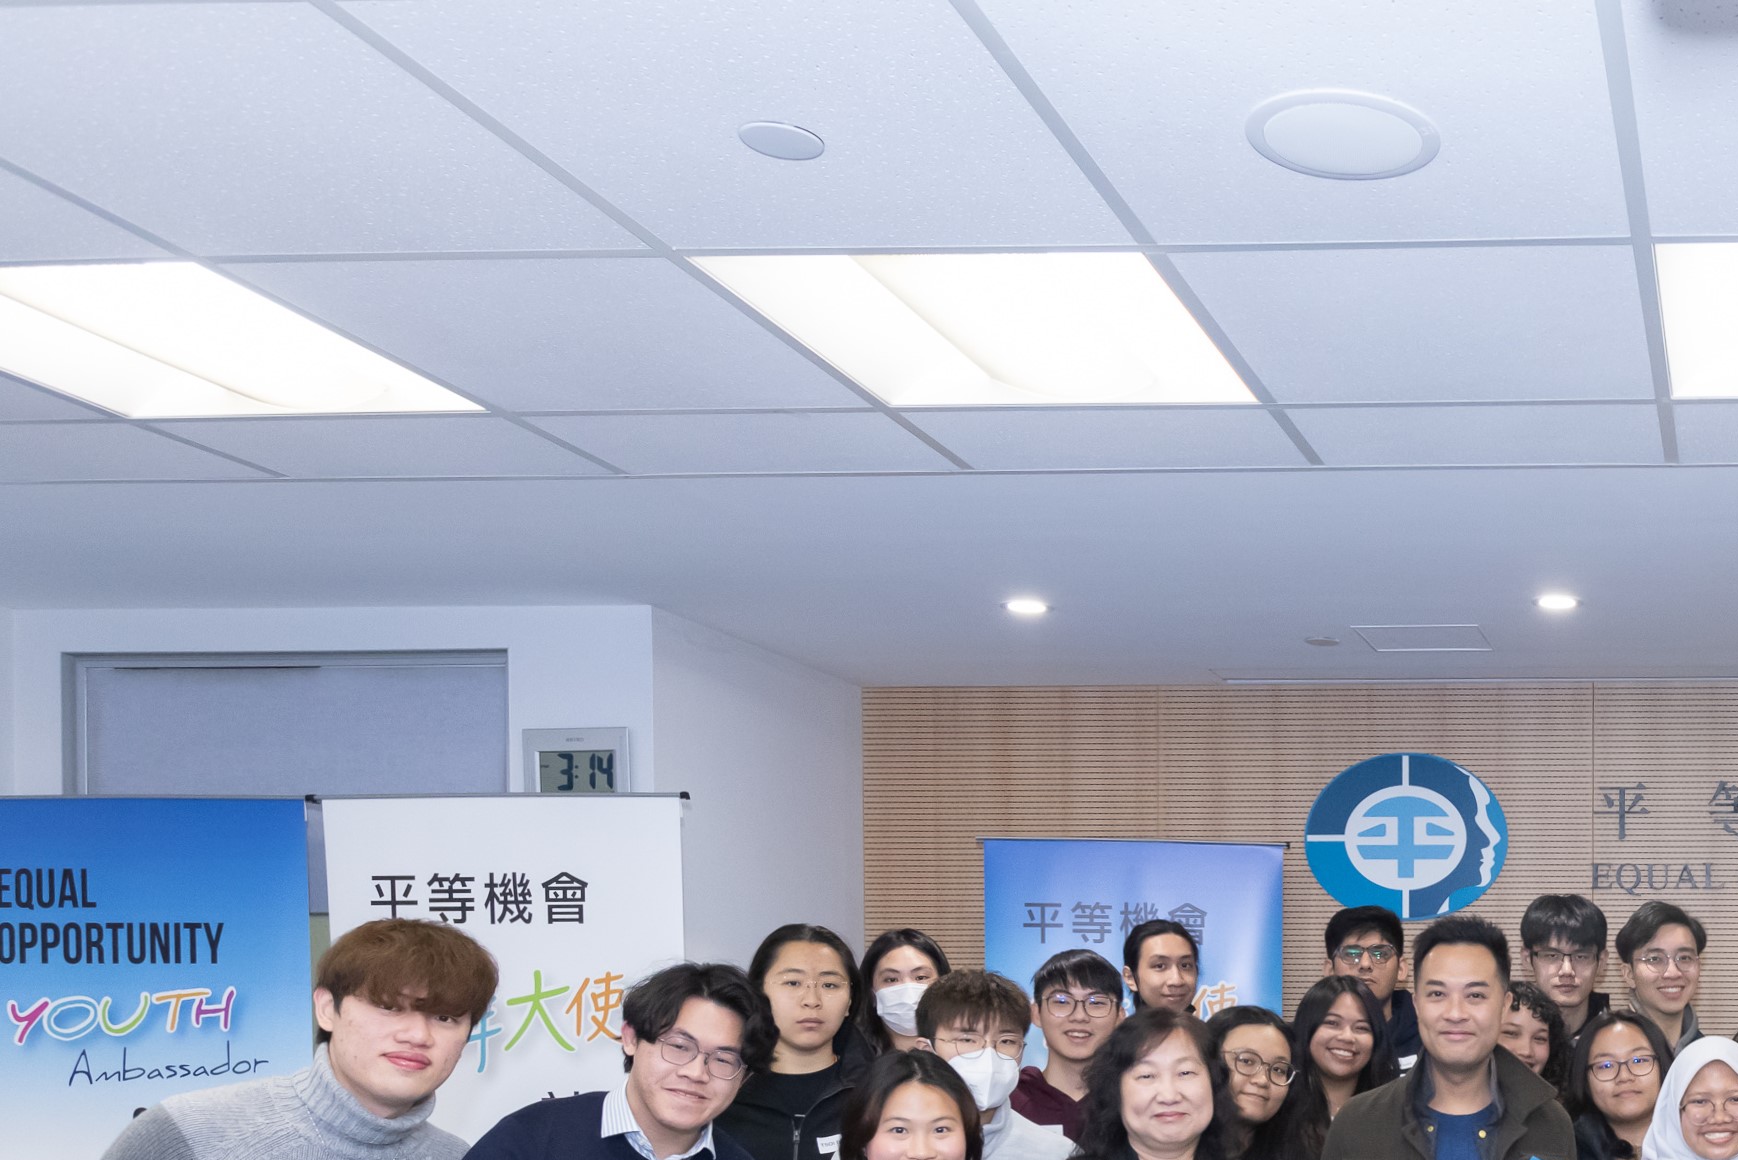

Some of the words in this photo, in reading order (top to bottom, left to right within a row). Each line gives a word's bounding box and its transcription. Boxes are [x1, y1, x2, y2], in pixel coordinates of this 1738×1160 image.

[557, 753, 614, 791] 3:14
[0, 868, 97, 910] EQUAL
[371, 871, 589, 925] 平等機會
[1592, 862, 1726, 896] EQUAL
[0, 922, 224, 965] OPPORTUNITY
[9, 988, 235, 1046] YOUTH
[68, 1040, 269, 1087] Ambassador
